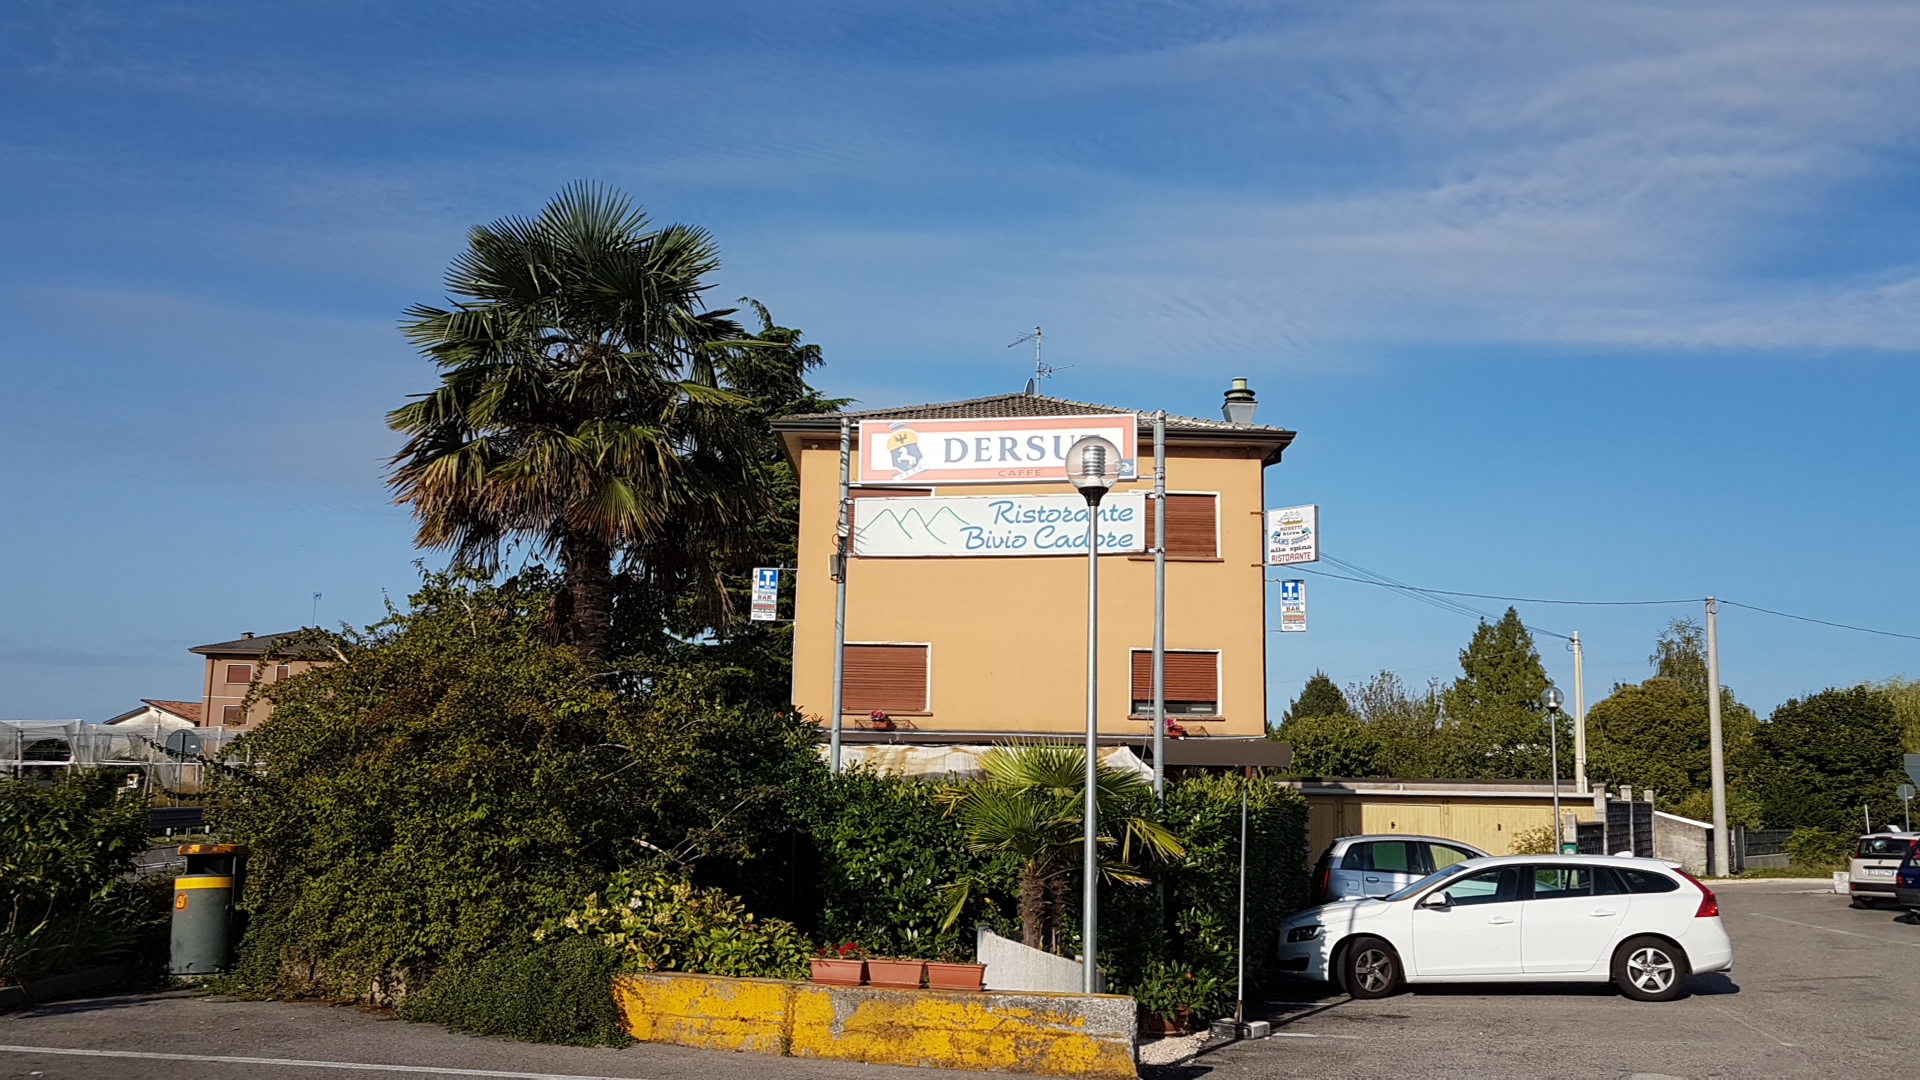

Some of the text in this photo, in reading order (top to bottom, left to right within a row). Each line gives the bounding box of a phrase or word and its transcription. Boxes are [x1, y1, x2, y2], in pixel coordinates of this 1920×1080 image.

[944, 433, 1100, 463] DERSU
[988, 500, 1134, 525] Ristorante
[960, 525, 1134, 550] Bivio Cadore
[1271, 552, 1311, 562] RISTORANTE
